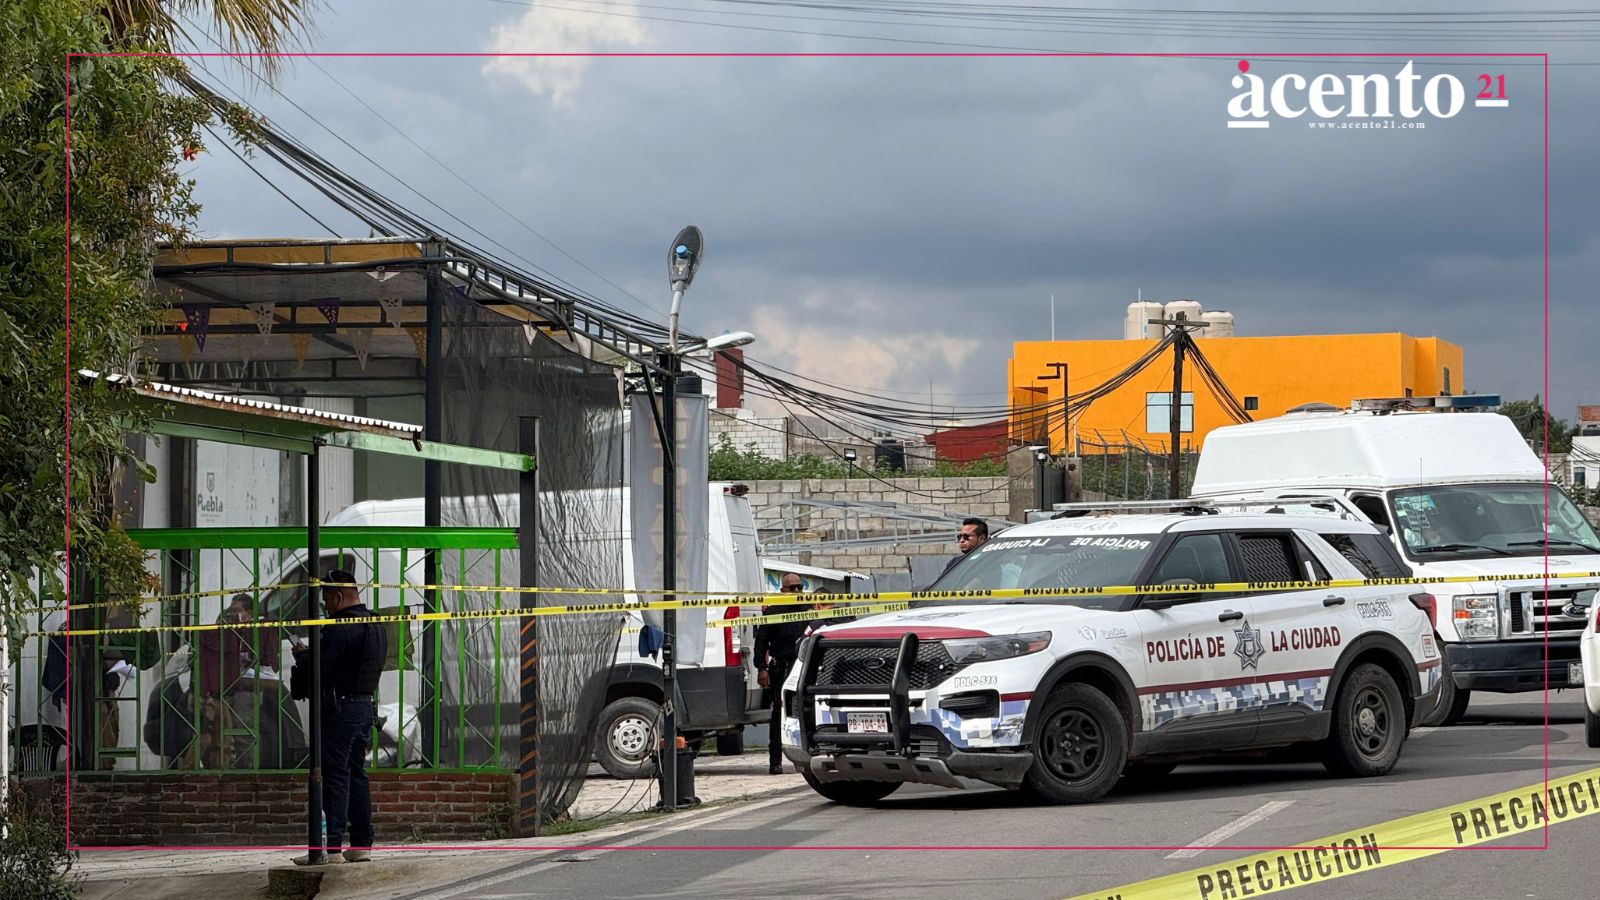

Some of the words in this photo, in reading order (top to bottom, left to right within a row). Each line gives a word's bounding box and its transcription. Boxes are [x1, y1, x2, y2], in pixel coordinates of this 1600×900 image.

[197, 493, 224, 512] Puebla
[782, 611, 819, 621] PRECAUCION
[833, 606, 870, 616] PRECAUCION
[1147, 633, 1204, 663] POLICÍA
[1206, 636, 1226, 658] DE
[1271, 630, 1289, 652] LA
[1292, 625, 1341, 650] CIUDAD
[1197, 832, 1382, 900] PRECAUCION
